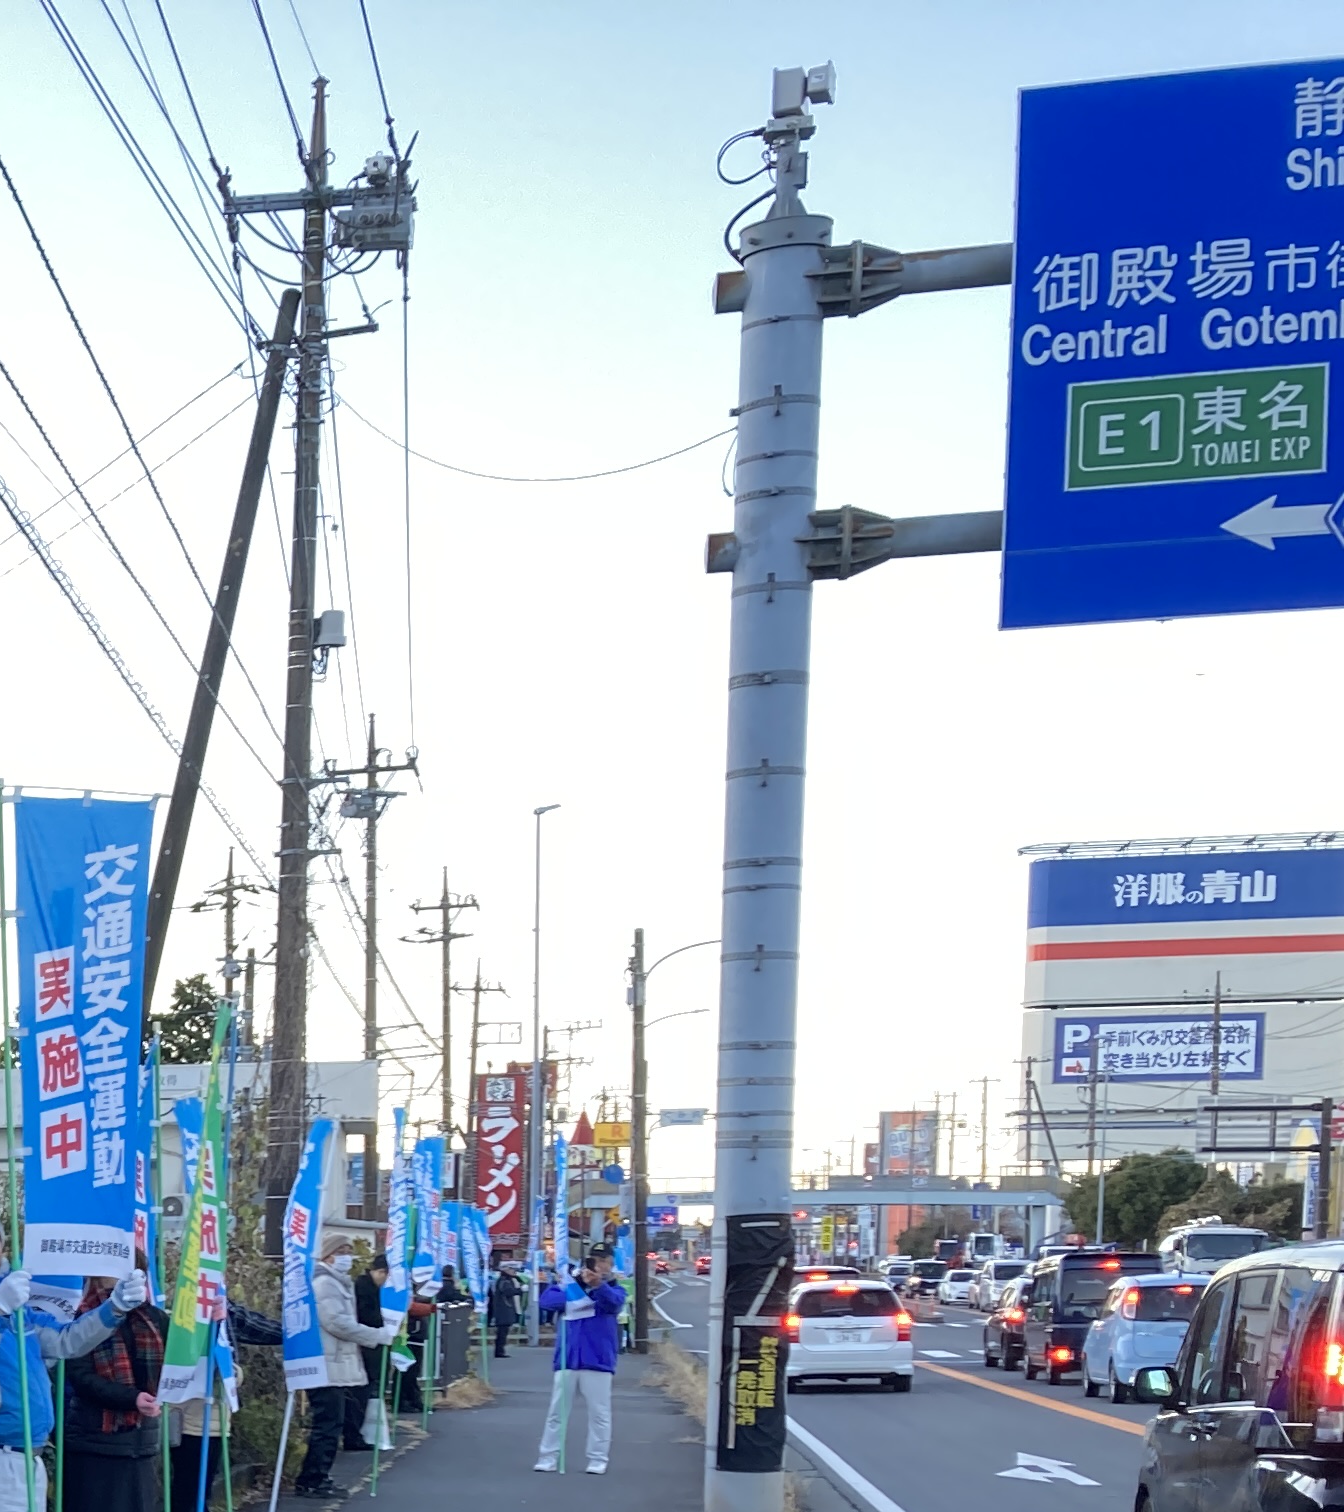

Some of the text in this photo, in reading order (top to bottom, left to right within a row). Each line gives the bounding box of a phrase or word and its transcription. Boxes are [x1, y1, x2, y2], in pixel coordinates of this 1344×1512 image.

[1021, 299, 1344, 366] Central Gotem
[1191, 380, 1309, 436] 東名
[1191, 436, 1311, 467] TOMEI EXP
[1113, 869, 1277, 908] 洋服の青山
[80, 842, 140, 1189] 交通安全運動
[1064, 1024, 1091, 1053] P
[39, 956, 83, 1170] 実施中
